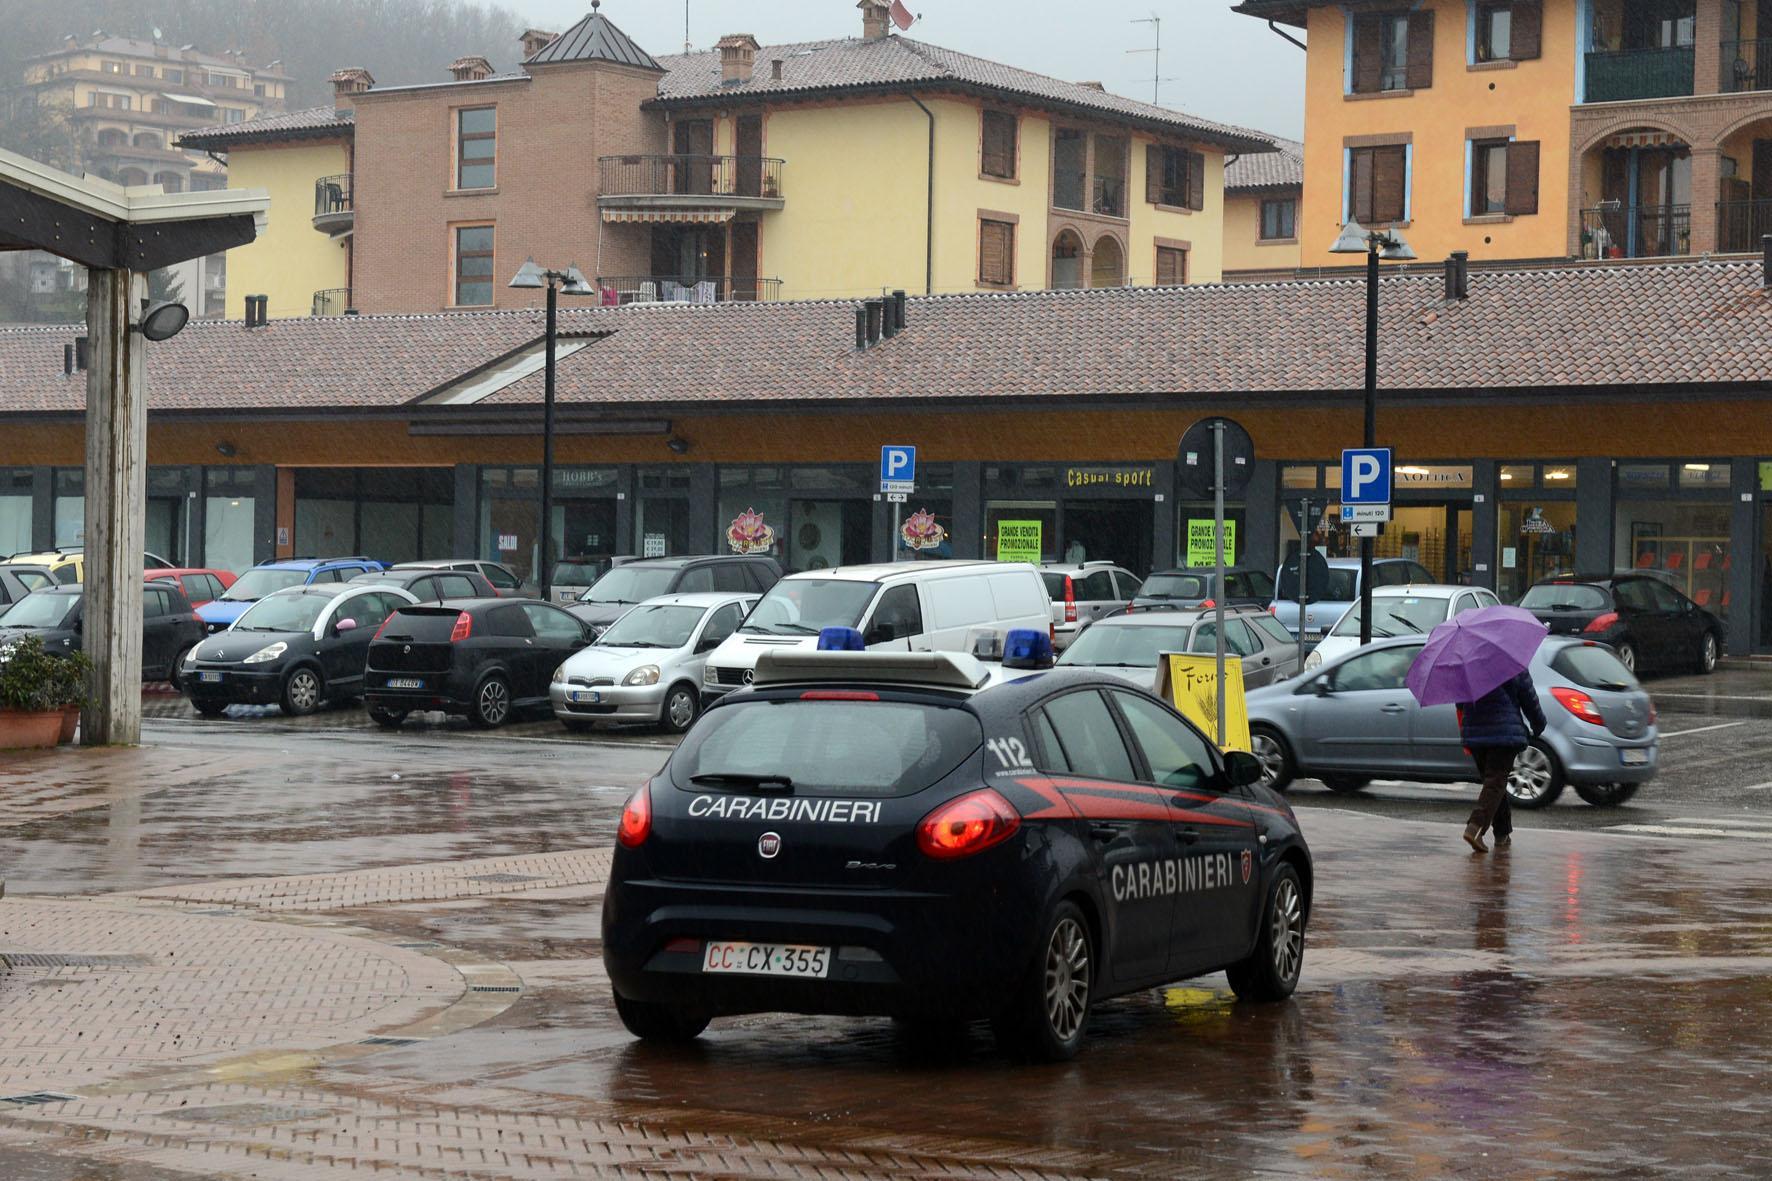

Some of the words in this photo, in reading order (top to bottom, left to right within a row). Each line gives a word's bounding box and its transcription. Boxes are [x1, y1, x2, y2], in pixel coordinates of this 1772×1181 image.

[888, 450, 908, 477] P
[1351, 455, 1381, 498] P
[1068, 469, 1109, 487] Casual
[1115, 469, 1152, 487] sport
[498, 535, 518, 550] SALDI
[1001, 526, 1019, 537] GRANDE
[1019, 526, 1039, 537] VENDITA
[1001, 539, 1039, 550] PROMOZIONALE
[1191, 526, 1211, 537] GRANDE
[987, 737, 1034, 768] 112
[688, 795, 883, 823] CARABINIERI
[1112, 852, 1233, 902] CARABINIERI
[708, 945, 735, 969] CC
[746, 946, 775, 971] CX
[782, 948, 826, 974] 355
